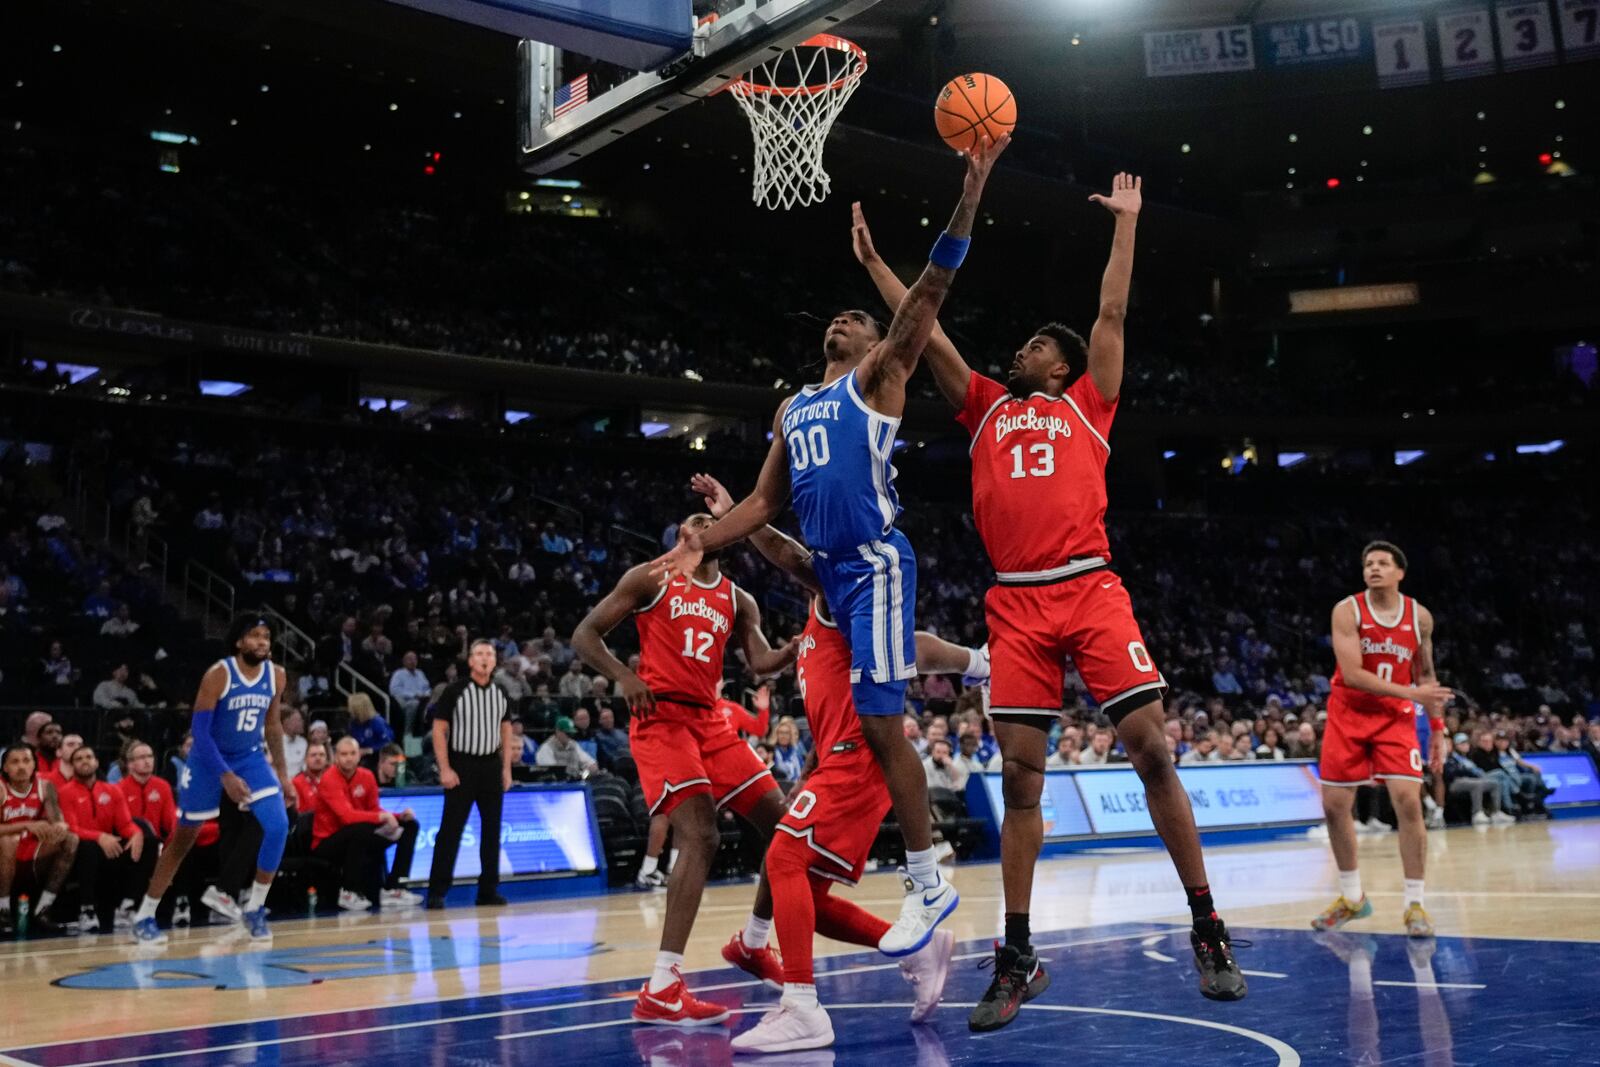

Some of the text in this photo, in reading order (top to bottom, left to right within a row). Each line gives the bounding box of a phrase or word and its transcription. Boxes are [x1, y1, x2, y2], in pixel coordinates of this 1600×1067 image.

[1306, 18, 1361, 55] 150
[1515, 19, 1538, 51] 3
[1573, 9, 1597, 43] 7
[1216, 29, 1248, 59] 15
[1393, 38, 1410, 70] 1
[1455, 29, 1478, 61] 2
[995, 406, 1072, 443] Buckeyes
[788, 424, 830, 471] 00
[1010, 443, 1055, 479] 13
[669, 595, 729, 634] Buckeyes
[681, 627, 715, 663] 12
[1360, 637, 1413, 664] Buckeyes
[1377, 662, 1393, 685] 0
[228, 693, 272, 711] KENTUCKY
[236, 708, 260, 732] 15
[1100, 793, 1126, 813] ALL
